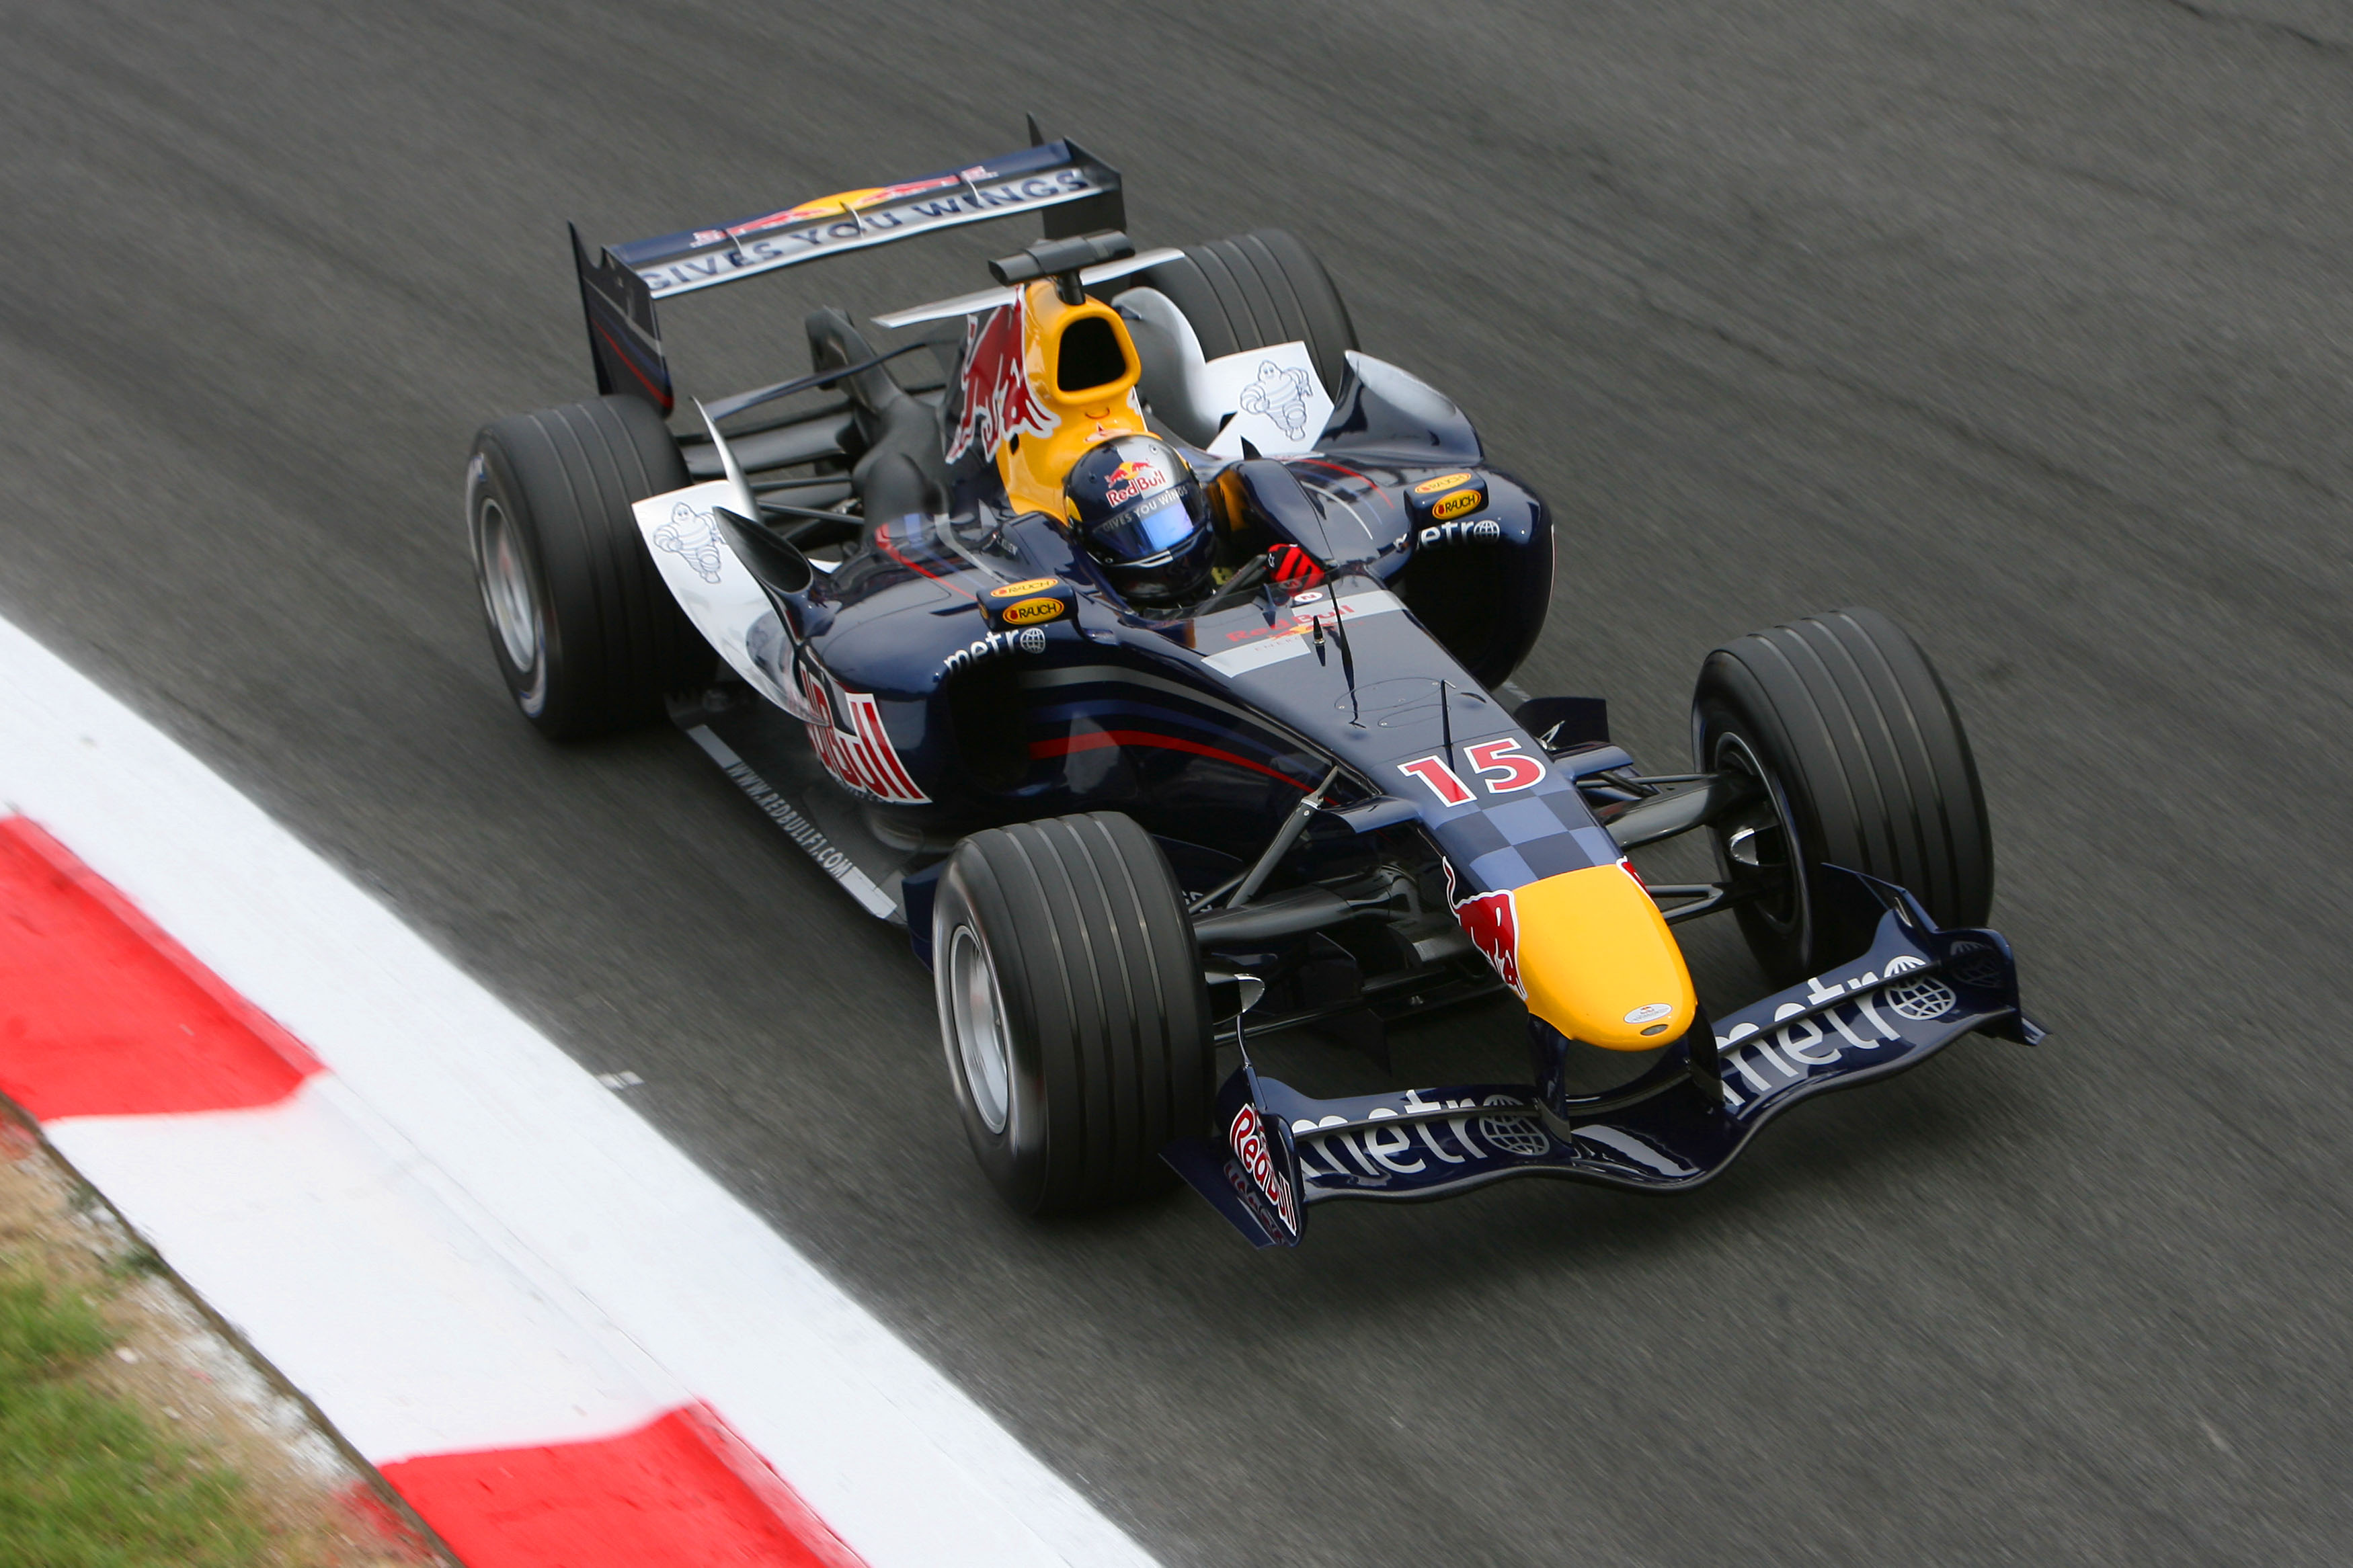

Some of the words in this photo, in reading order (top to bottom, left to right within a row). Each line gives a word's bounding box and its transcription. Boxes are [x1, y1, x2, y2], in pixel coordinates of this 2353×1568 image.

[641, 243, 783, 290] GIVES
[789, 211, 903, 245] YOU
[1106, 479, 1140, 508] Red
[1137, 470, 1166, 492] Bull
[1445, 495, 1476, 513] RAUCH
[1103, 513, 1133, 532] GIVES
[1133, 501, 1157, 517] YOU
[1019, 603, 1058, 619] RAUCH
[1226, 619, 1291, 642] Red
[1397, 737, 1546, 808] 15
[727, 760, 853, 878] WWW.REDBULLF1.COM
